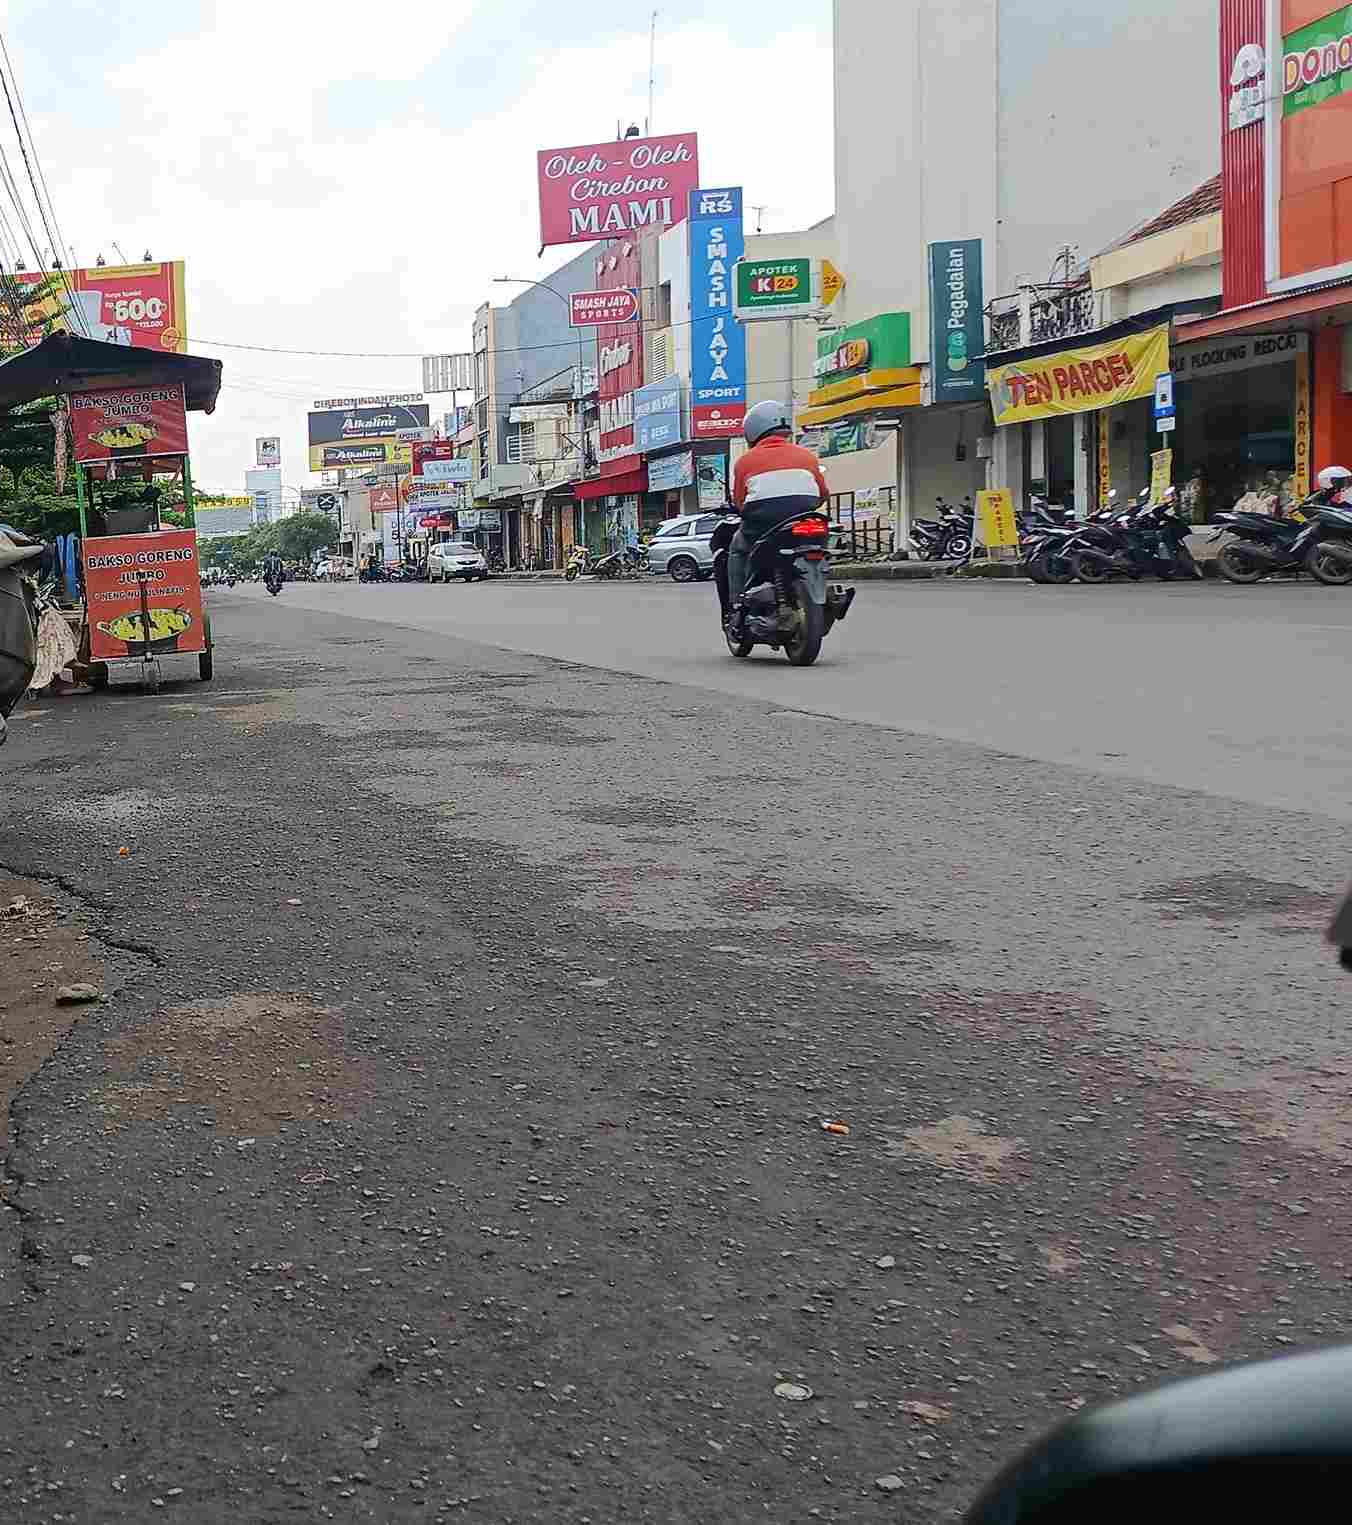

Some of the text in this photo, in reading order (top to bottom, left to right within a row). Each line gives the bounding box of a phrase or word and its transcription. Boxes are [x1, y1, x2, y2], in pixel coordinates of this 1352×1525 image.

[544, 153, 607, 178] Oleh
[630, 143, 692, 169] Oleh
[571, 175, 669, 200] Cirebon
[568, 197, 673, 236] MAMI
[749, 265, 799, 276] APOTEK
[757, 278, 794, 292] K 24
[946, 248, 969, 329] Pegadaian
[573, 295, 631, 310] SMASH JAYA
[580, 308, 625, 319] SPORTS
[709, 318, 729, 381] JAYA
[1006, 351, 1136, 408] TEN PARCEL
[73, 390, 179, 409] BAKSO GORENG
[697, 387, 742, 399] SPORT
[104, 403, 152, 418] JUMBO
[87, 548, 193, 569] BAKSO GORENG
[119, 569, 165, 584] JUMBO
